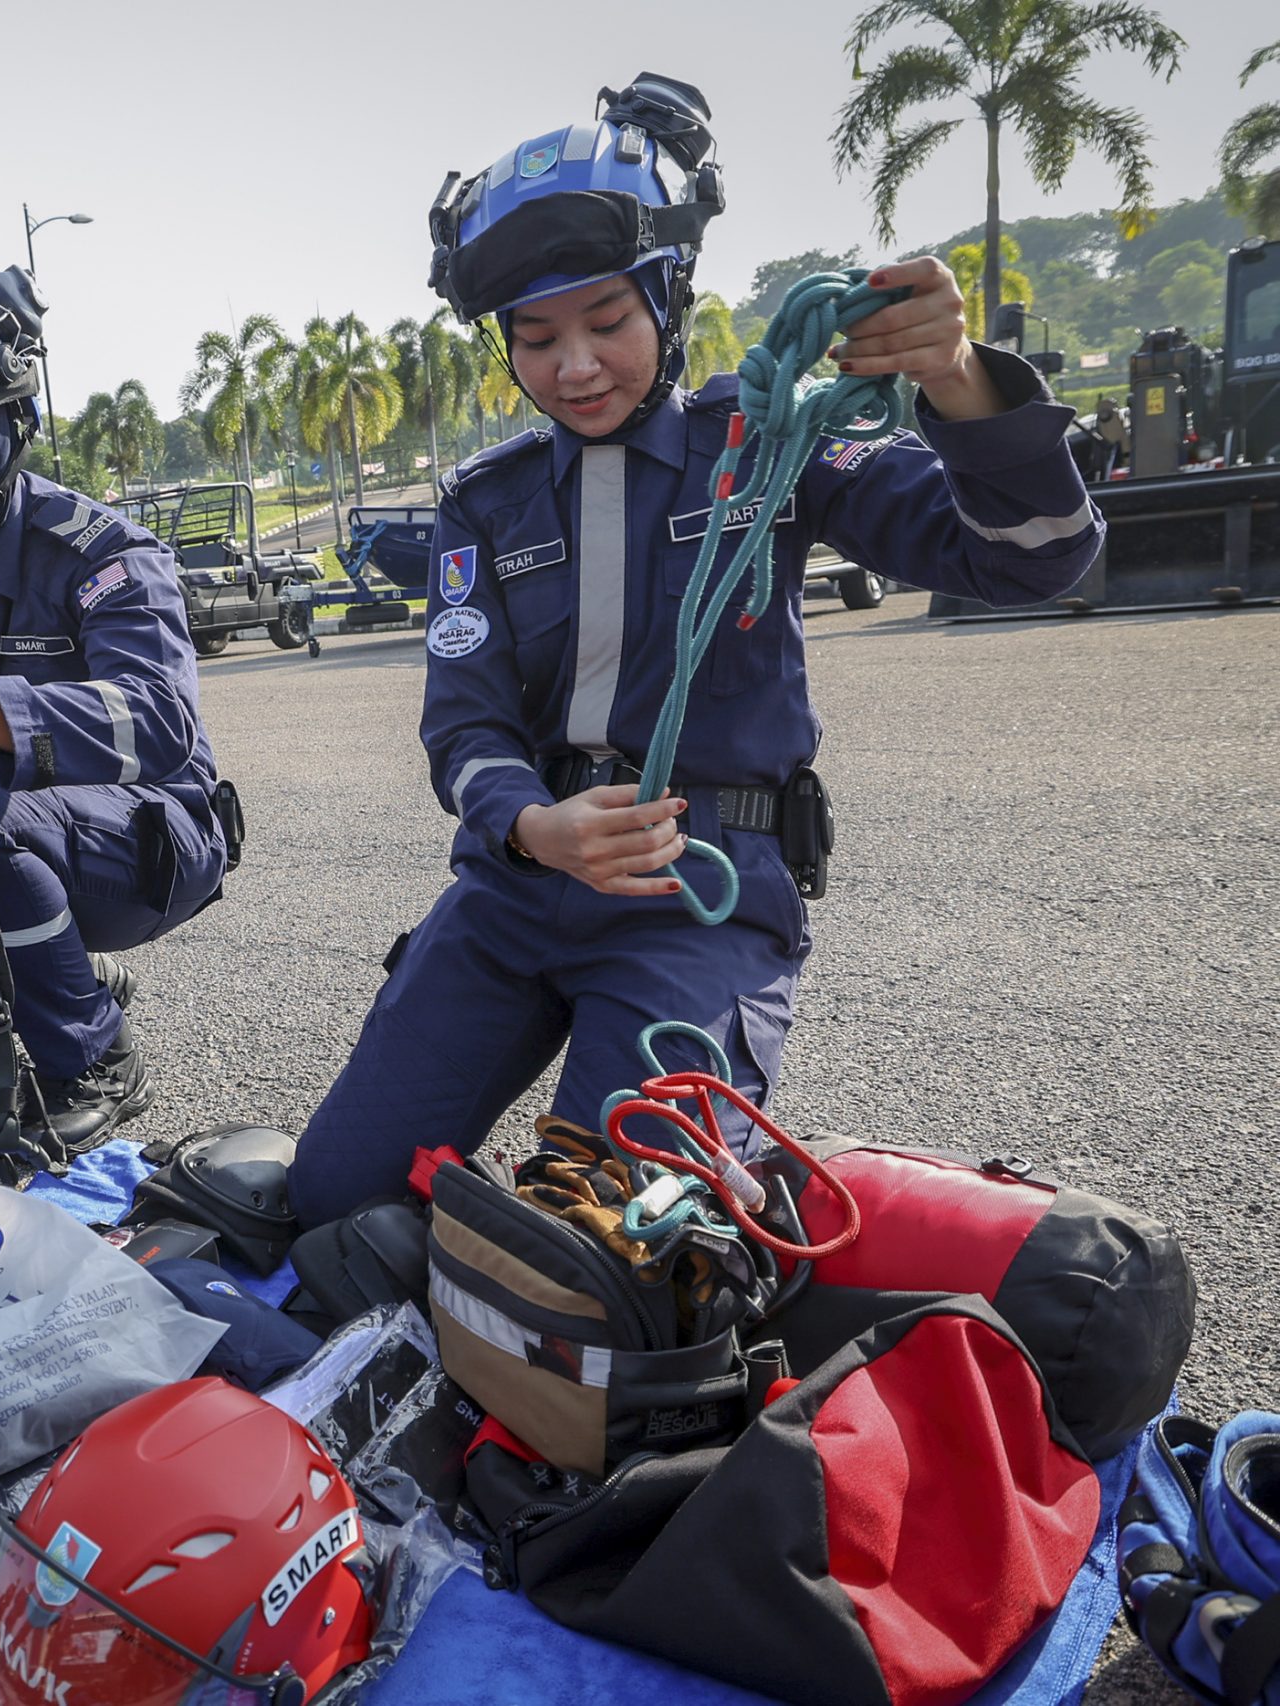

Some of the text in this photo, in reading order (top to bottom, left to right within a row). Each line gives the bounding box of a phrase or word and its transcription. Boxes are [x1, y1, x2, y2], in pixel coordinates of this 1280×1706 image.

[847, 434, 898, 471] MALAYSIA
[707, 504, 762, 525] MART
[76, 516, 114, 548] SMART
[416, 531, 426, 540] 03
[88, 581, 127, 610] MALAYSIA
[392, 590, 402, 599] 03
[445, 585, 469, 597] SMART
[432, 610, 482, 630] UNITED NATIONS
[438, 628, 475, 640] INSARAG
[16, 642, 46, 651] SMART
[81, 1283, 118, 1308] JALAN
[81, 1300, 127, 1324] SEKSYEN
[4, 1345, 56, 1377] Selangor
[59, 1328, 99, 1353] Malaysia
[34, 1372, 84, 1403] ds_tailor
[269, 1517, 351, 1612] SMART
